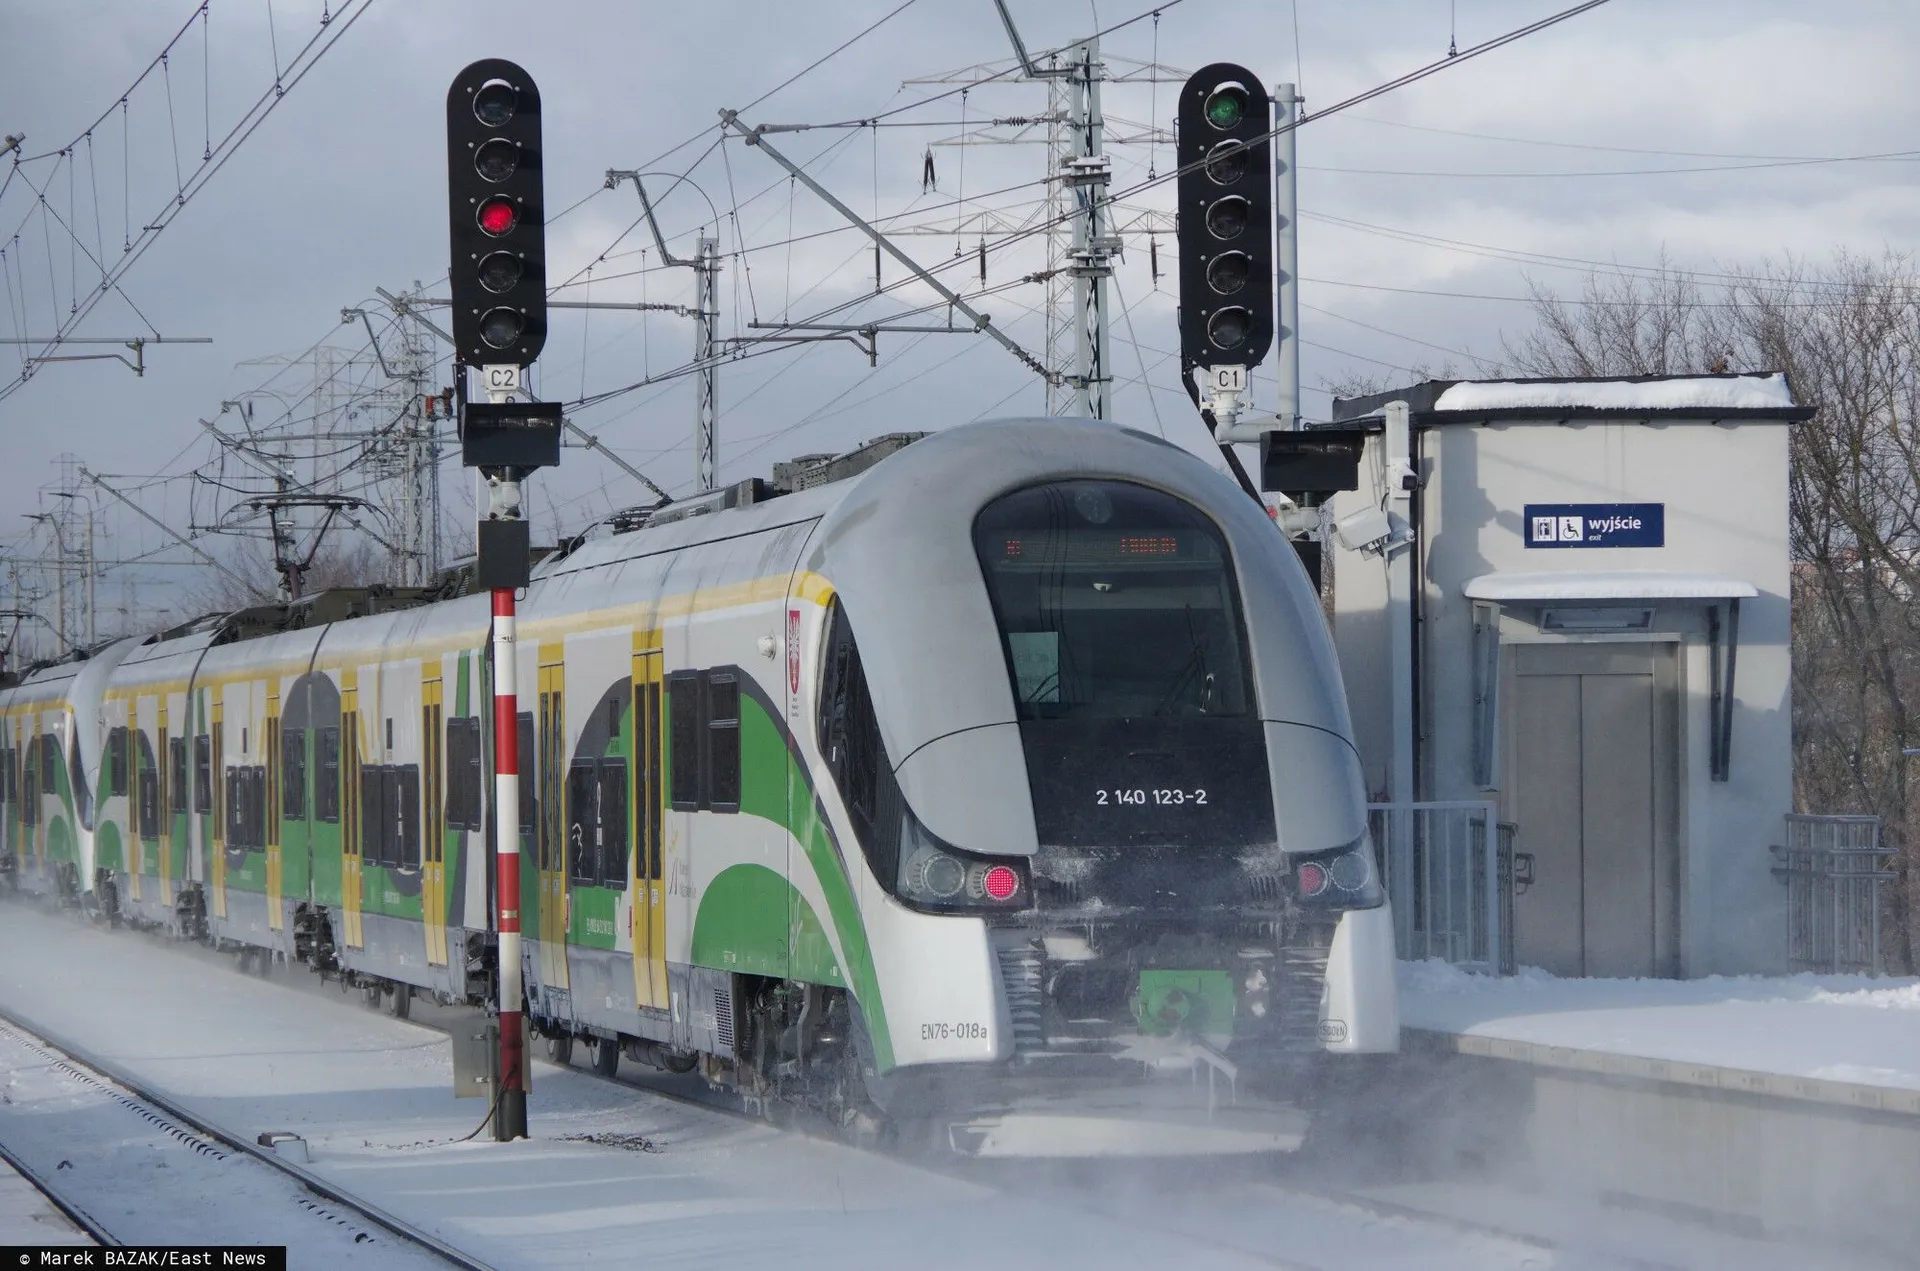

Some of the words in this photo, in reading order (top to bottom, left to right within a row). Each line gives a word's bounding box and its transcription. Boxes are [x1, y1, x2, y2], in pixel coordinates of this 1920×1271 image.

[491, 369, 514, 387] C2
[1219, 370, 1238, 388] C1
[1589, 516, 1642, 533] wyjście
[1096, 789, 1109, 805] 2
[1114, 789, 1146, 805] 140
[1152, 789, 1208, 805] 123-2
[921, 1022, 988, 1041] EN76-018a
